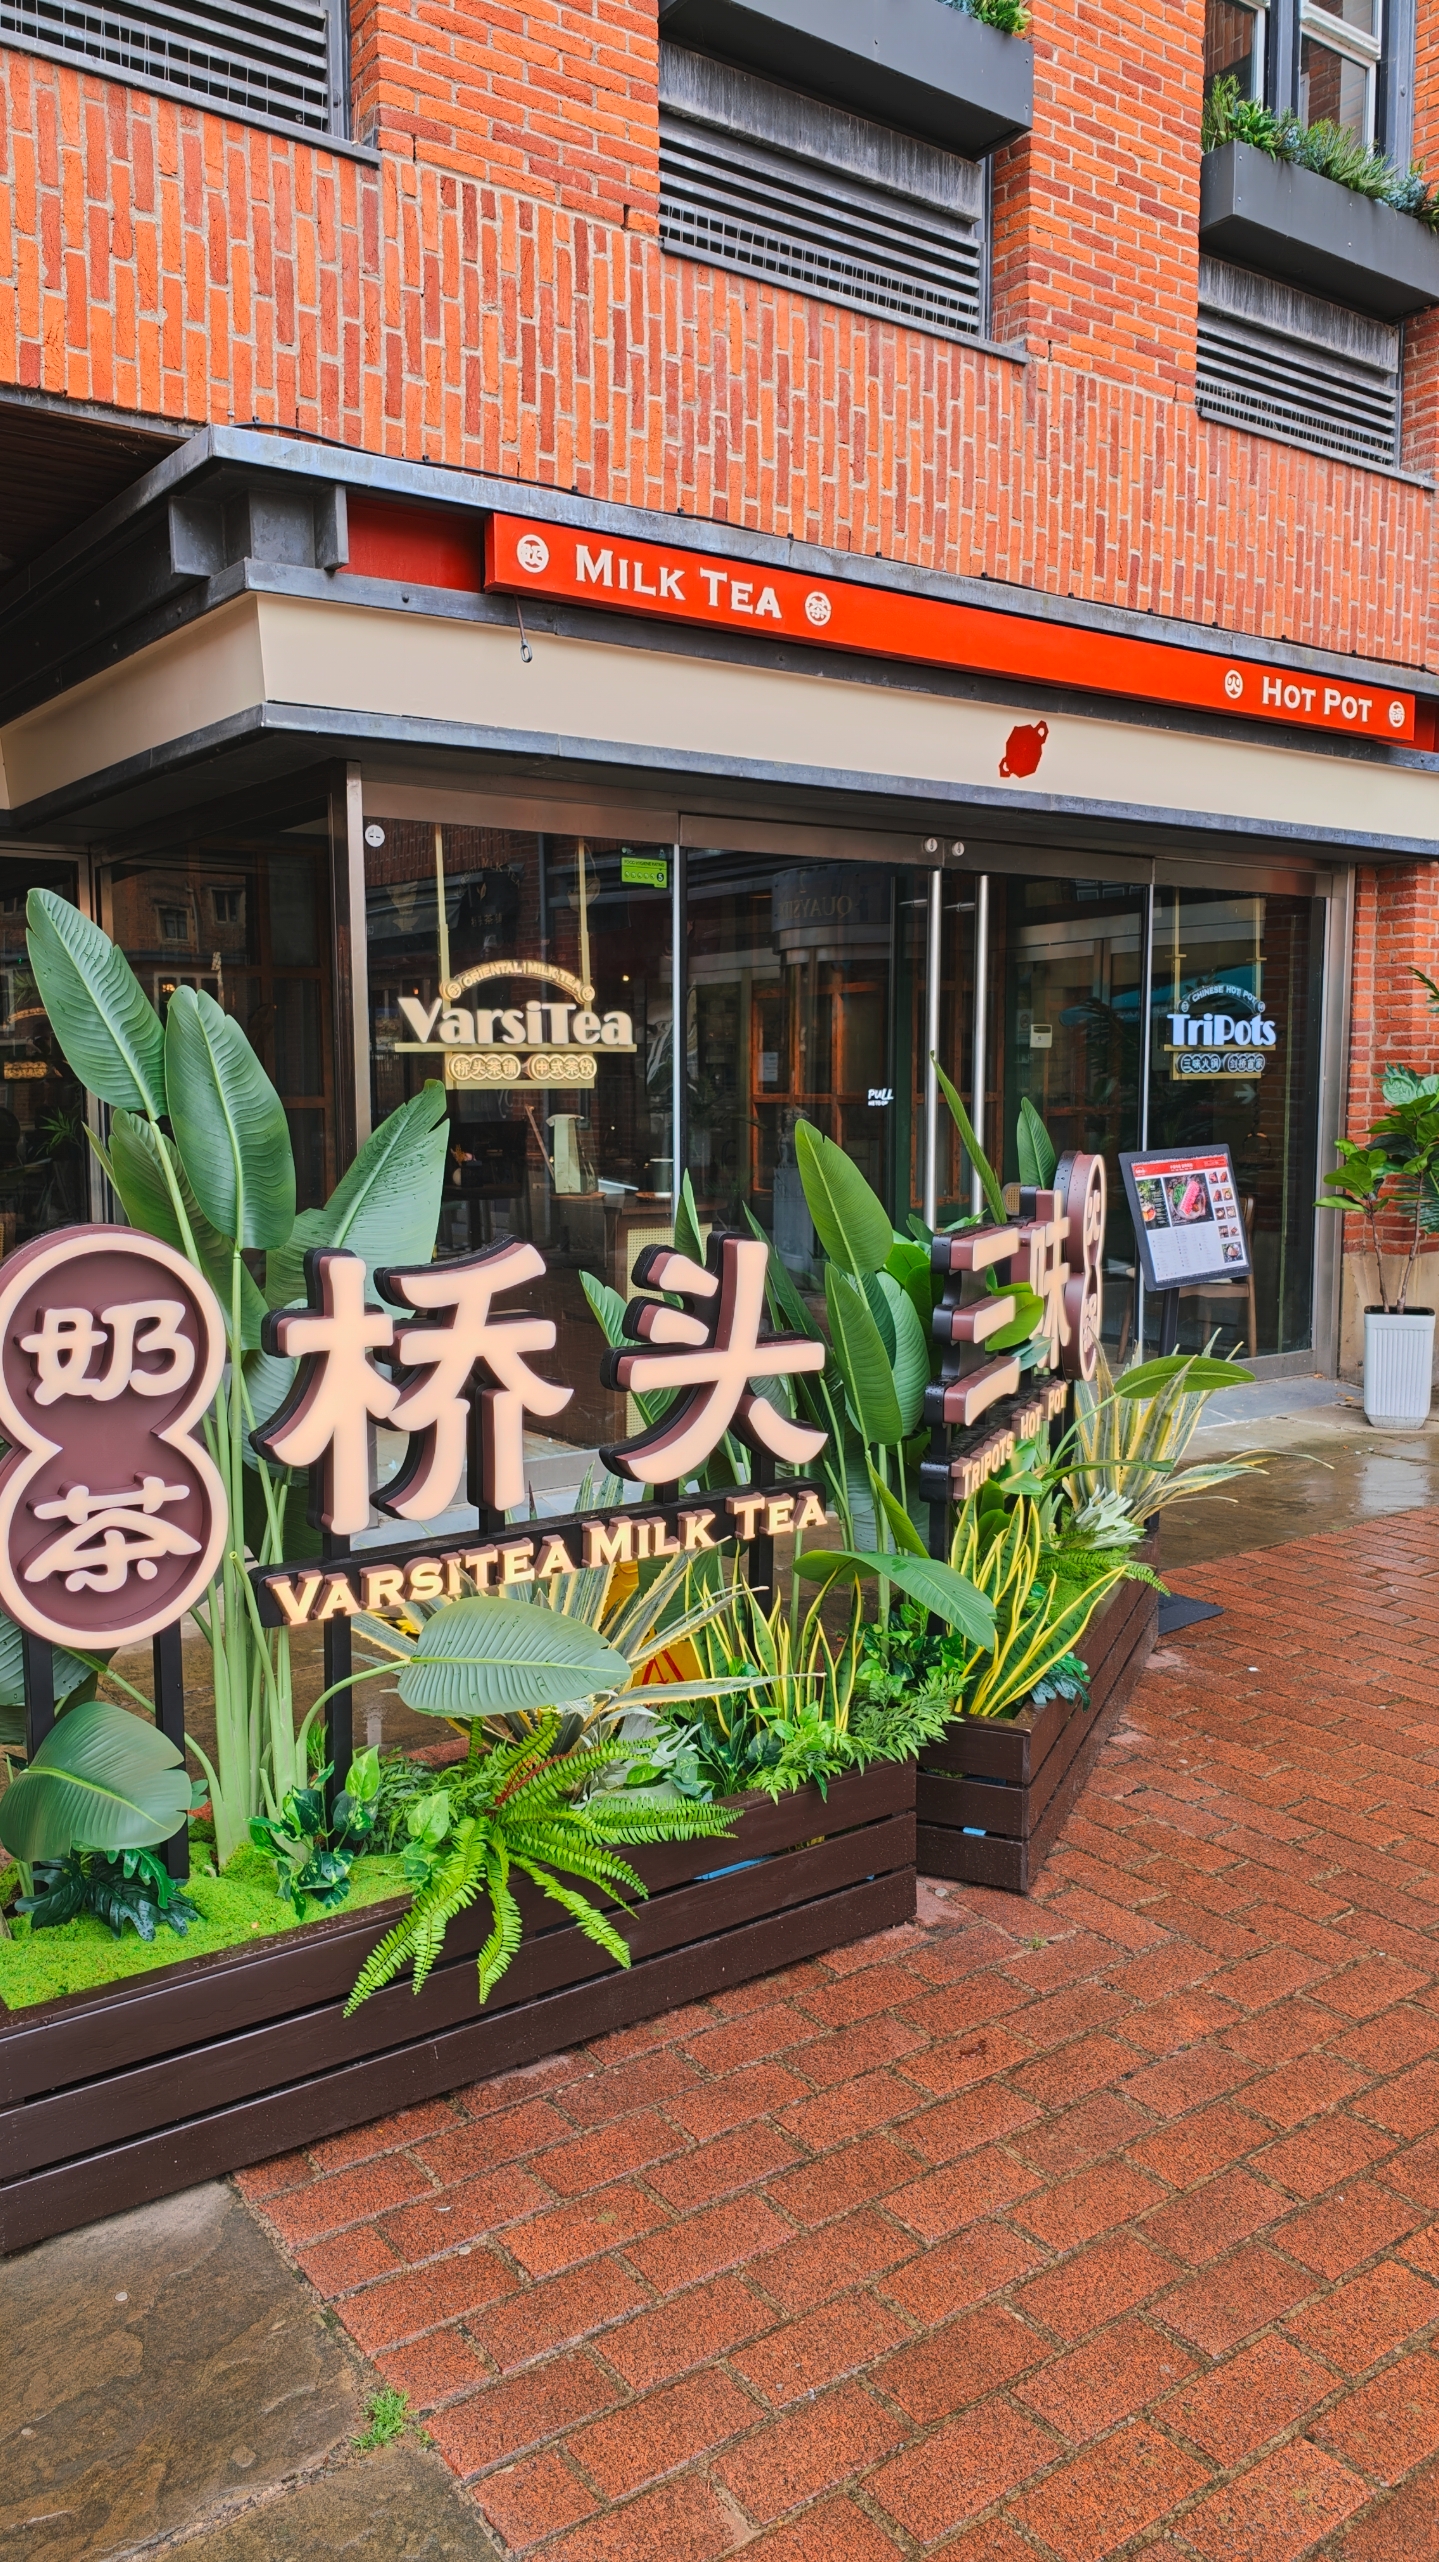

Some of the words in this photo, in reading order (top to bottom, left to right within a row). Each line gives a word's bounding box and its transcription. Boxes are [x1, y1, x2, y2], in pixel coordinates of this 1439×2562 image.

[575, 543, 687, 601] MILK
[700, 566, 783, 619] TEA
[1262, 676, 1316, 712] HOT
[1323, 688, 1372, 722] POT
[463, 962, 523, 987] ORIENTAL
[527, 962, 559, 979] MILK
[560, 971, 583, 993] TEA
[1192, 985, 1224, 1002] CHINESE
[1226, 985, 1241, 996] HOT
[1243, 990, 1257, 1004] POT
[397, 997, 633, 1045] VarsiTea
[1167, 1013, 1276, 1046] TriPots
[454, 1056, 518, 1078] 桥头茶铺
[535, 1056, 595, 1078] 中式茶饮
[868, 1088, 894, 1100] PULL
[252, 1233, 829, 1535] 桥头
[20, 1299, 202, 1594] 奶茶
[960, 1431, 1016, 1500] TRIPOTS
[1019, 1404, 1044, 1439] HOT
[1046, 1382, 1068, 1421] POT
[267, 1535, 576, 1626] VARSITEA
[584, 1509, 716, 1569] MILK
[728, 1491, 828, 1541] TEA
